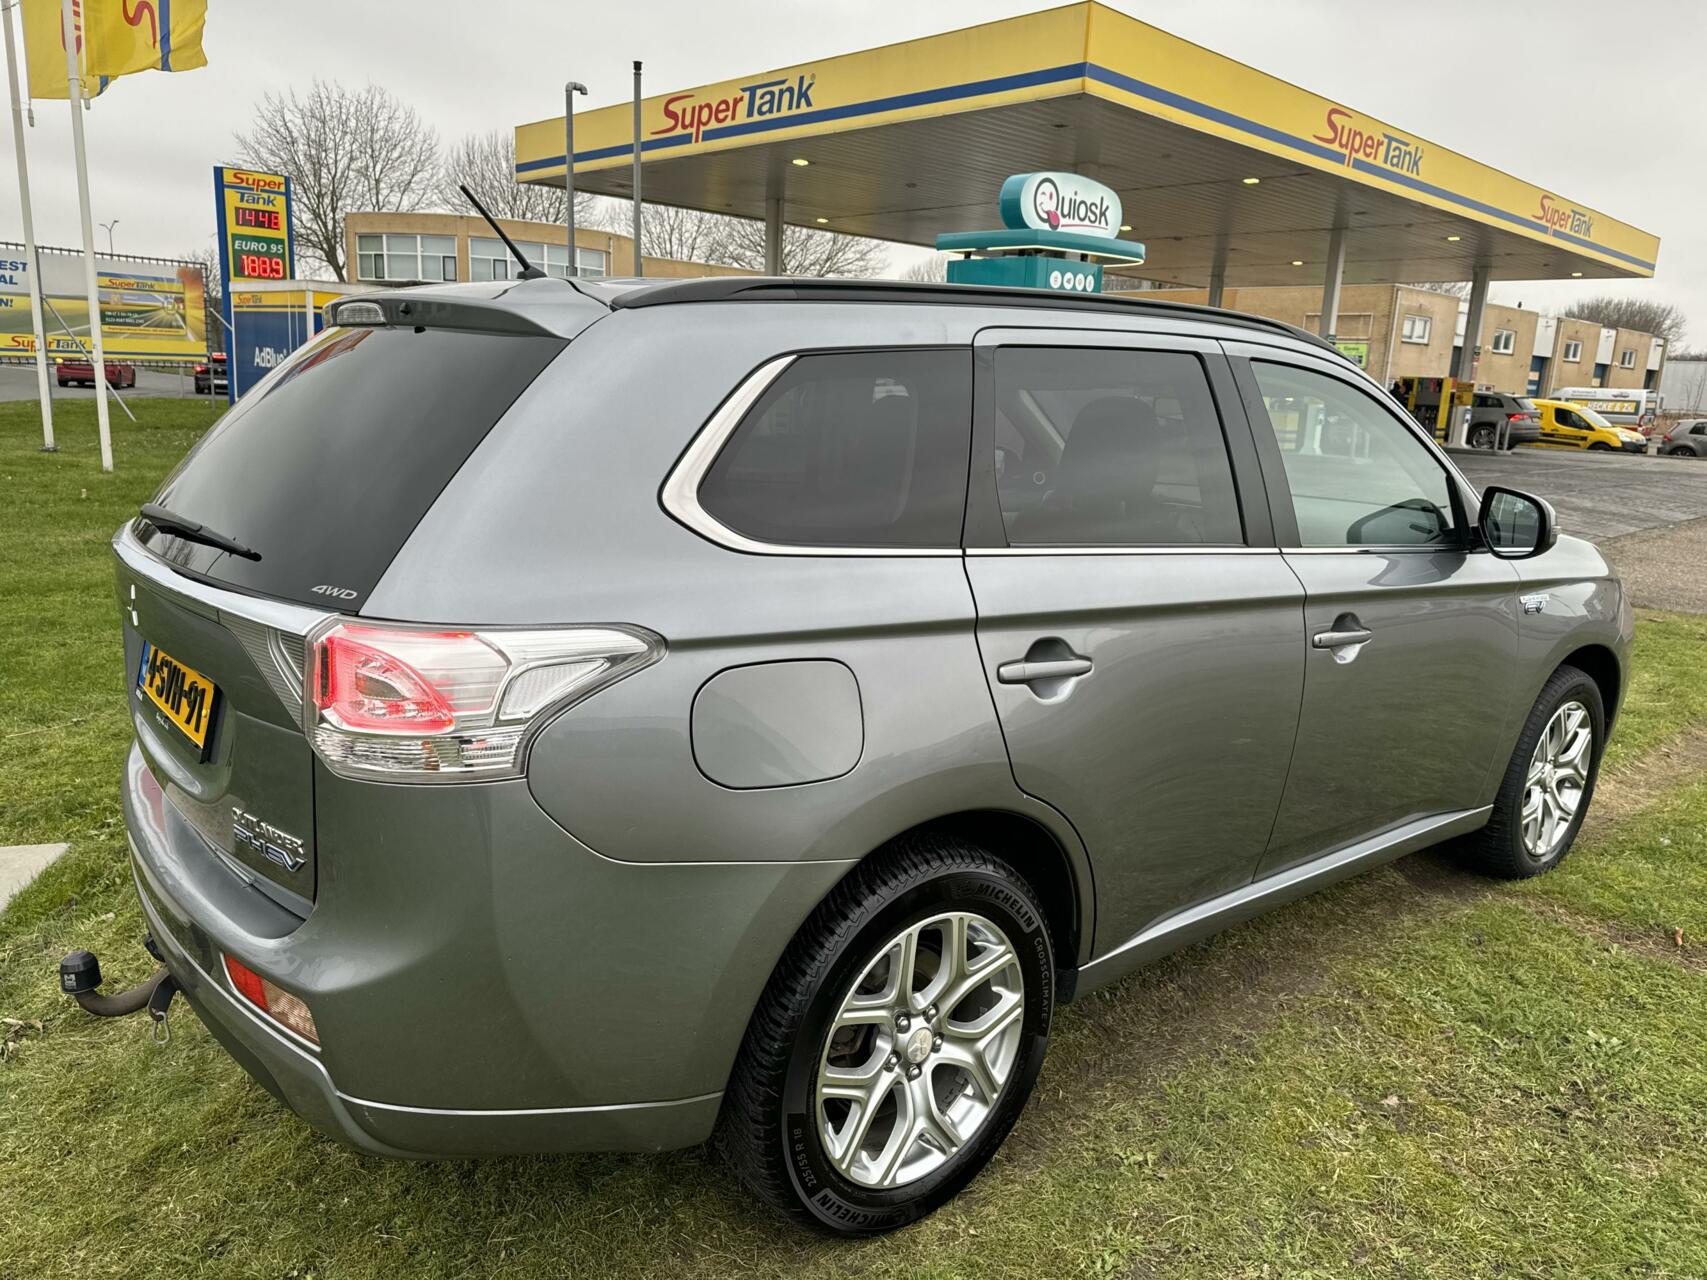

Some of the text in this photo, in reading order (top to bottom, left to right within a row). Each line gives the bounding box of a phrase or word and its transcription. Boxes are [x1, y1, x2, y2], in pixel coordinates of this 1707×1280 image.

[650, 75, 816, 143] SuperTank
[1313, 107, 1422, 176] SuperTank
[224, 171, 284, 193] Super
[234, 190, 277, 207] Tank
[1034, 177, 1110, 230] Quiosk
[1531, 194, 1593, 238] SuperTank
[234, 239, 284, 255] EURO 95
[4, 335, 88, 353] SuprTank
[311, 585, 358, 600] 4WD
[975, 882, 1036, 928] MICHELIN
[793, 1128, 817, 1188] 225/55 R 18
